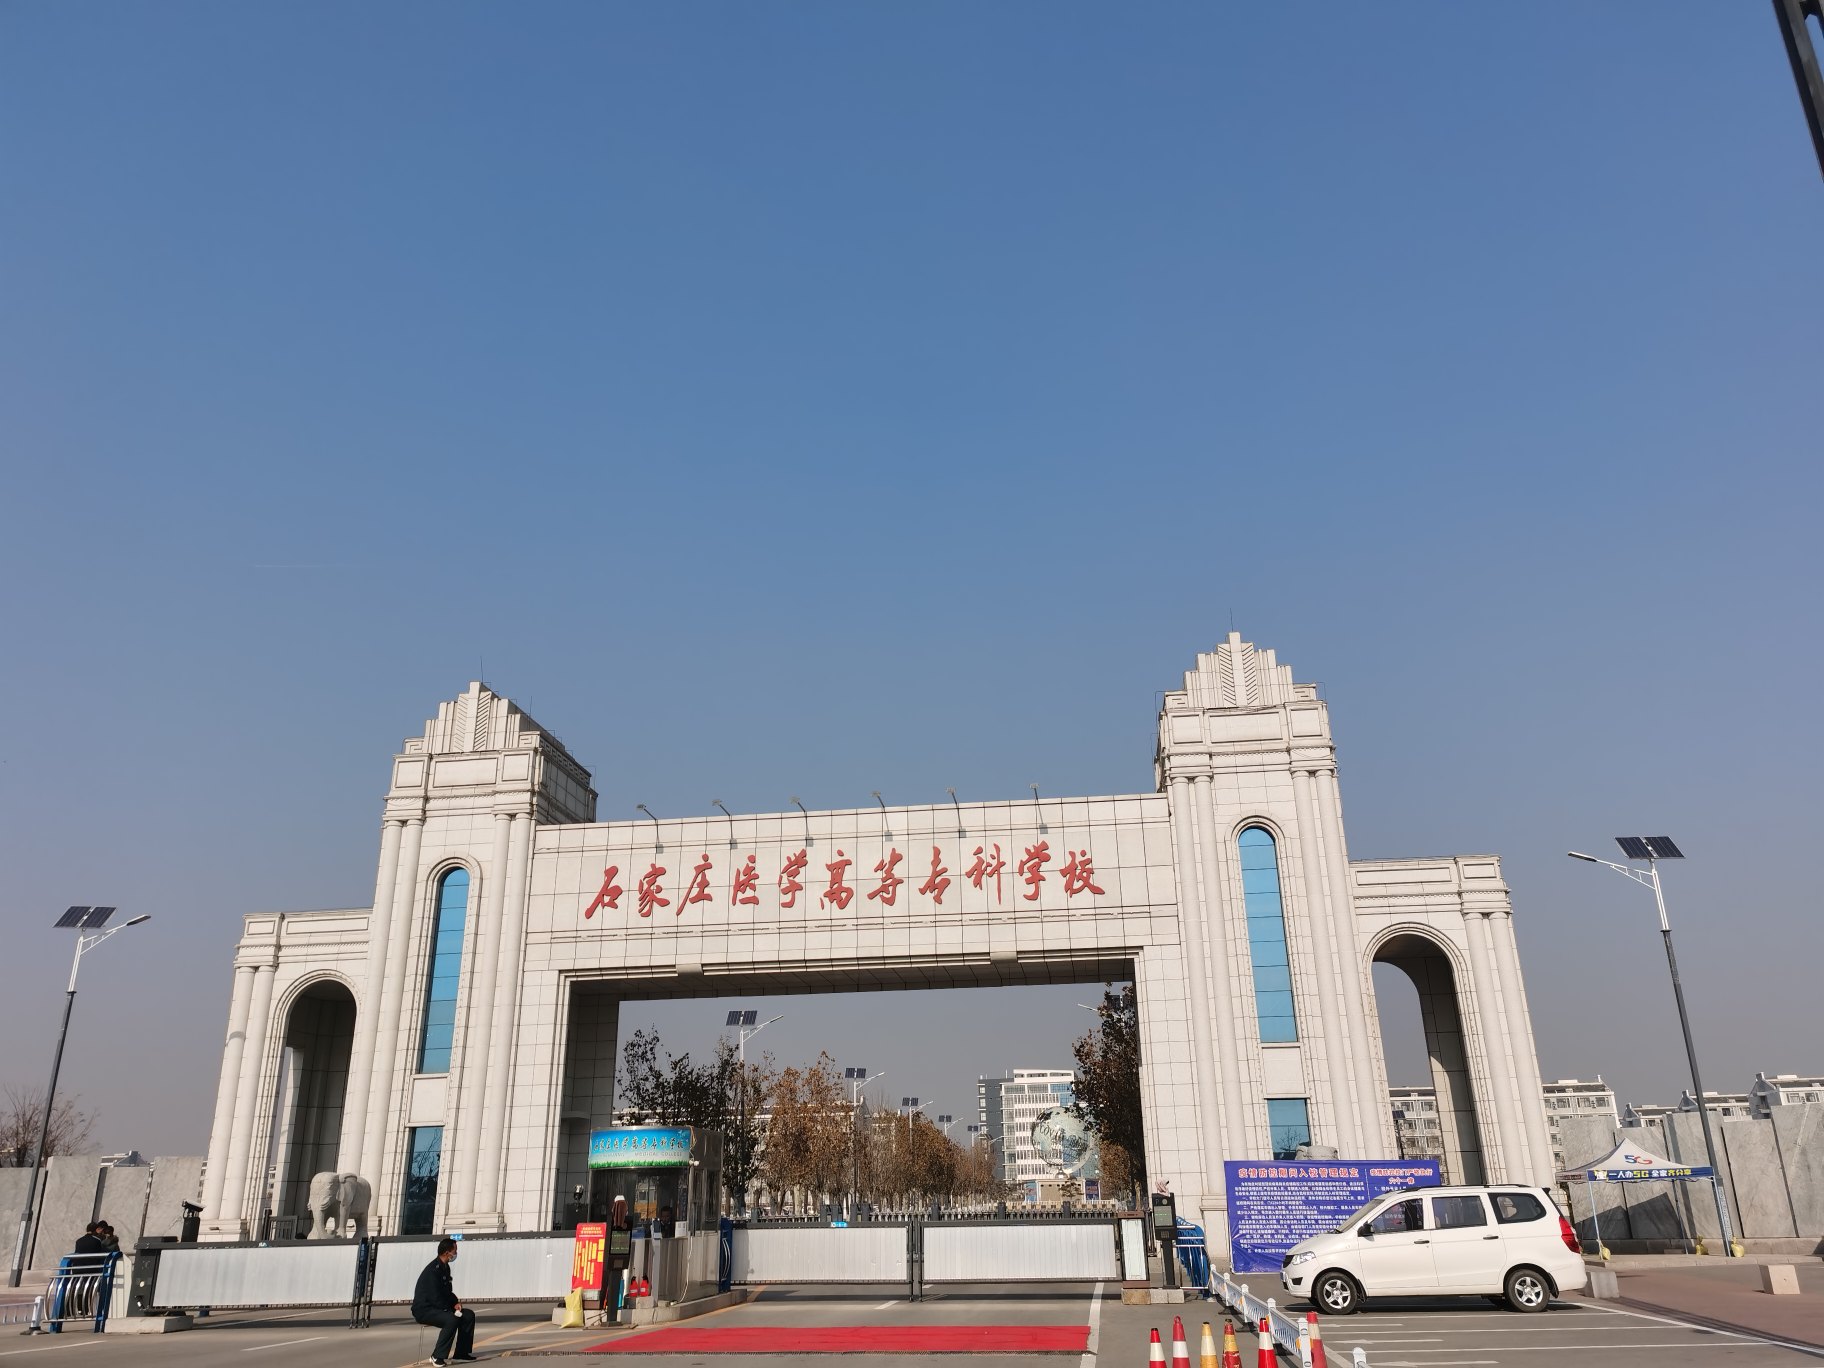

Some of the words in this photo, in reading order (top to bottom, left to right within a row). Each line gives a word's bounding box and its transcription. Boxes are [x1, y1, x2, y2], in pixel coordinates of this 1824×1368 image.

[585, 840, 1105, 919] 石家庄医学高等专科学校
[1238, 1167, 1359, 1178] 疫情防控期间入校管理规定
